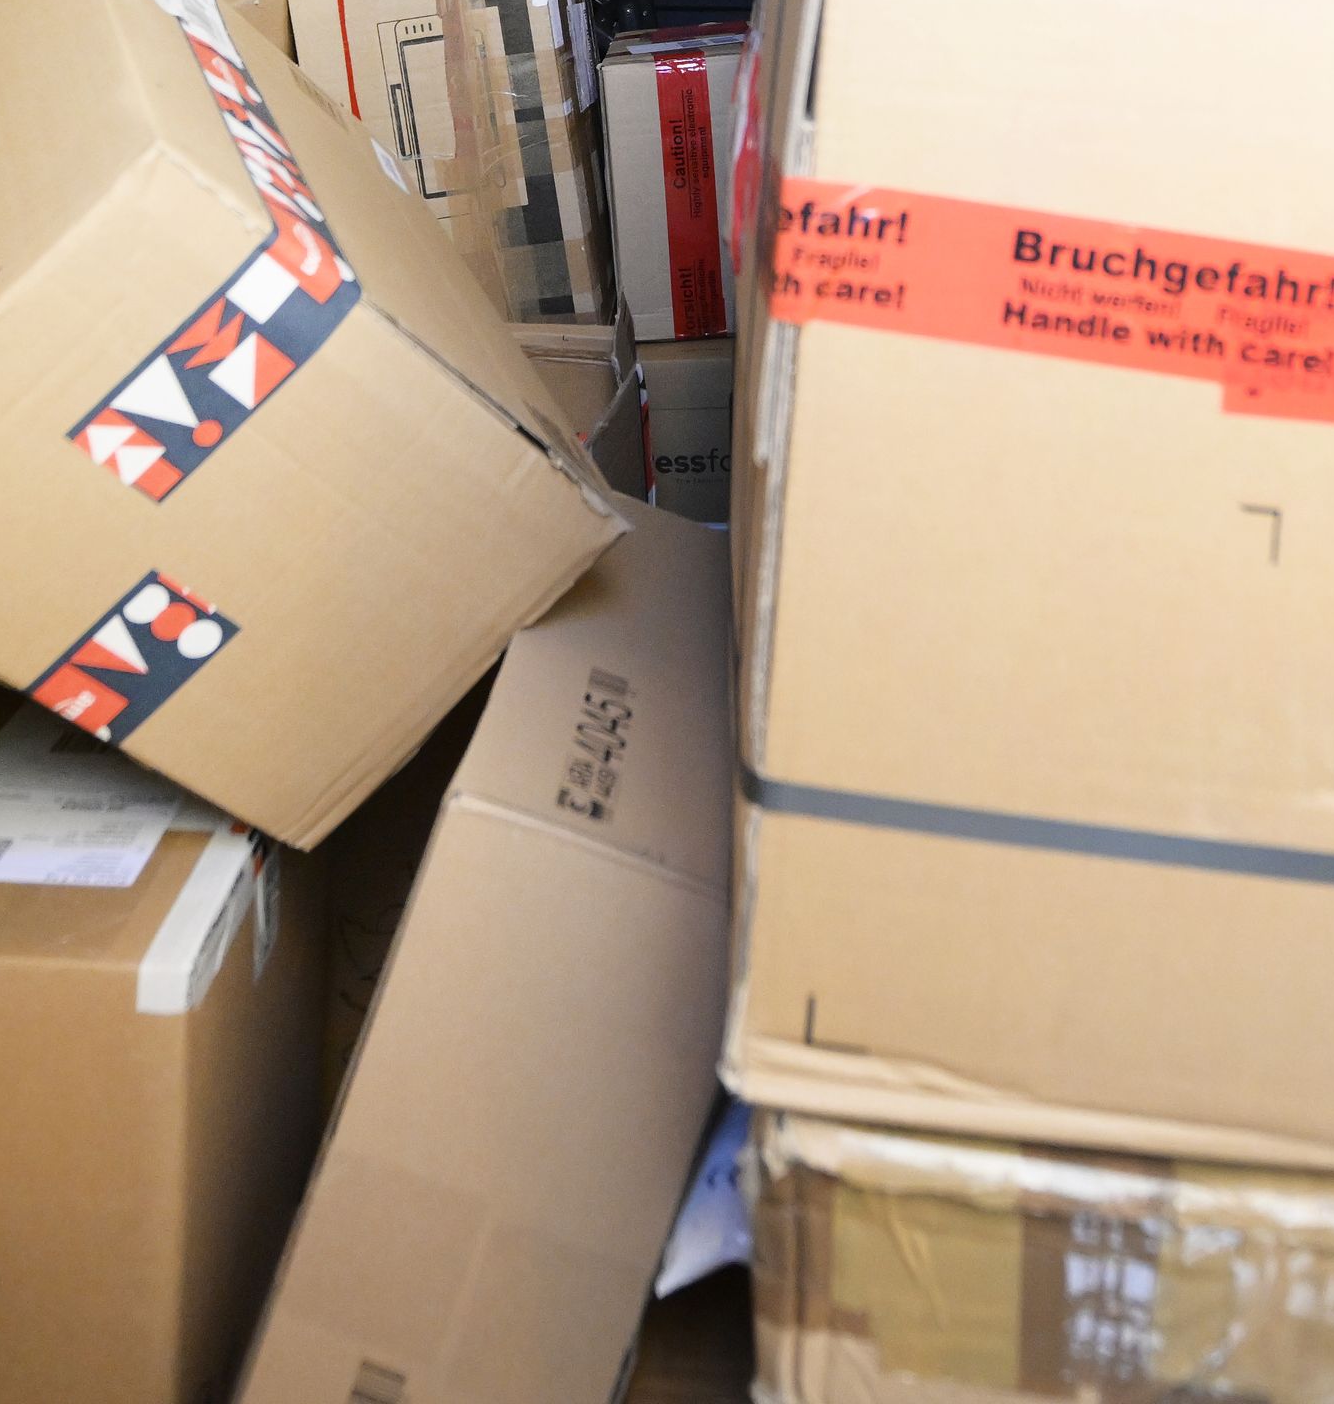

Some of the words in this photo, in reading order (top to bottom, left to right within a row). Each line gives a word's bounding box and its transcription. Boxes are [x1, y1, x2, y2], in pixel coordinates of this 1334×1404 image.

[669, 119, 686, 190] Caution!
[815, 277, 907, 310] care!
[1004, 301, 1130, 342] Handle
[1147, 326, 1225, 359] with
